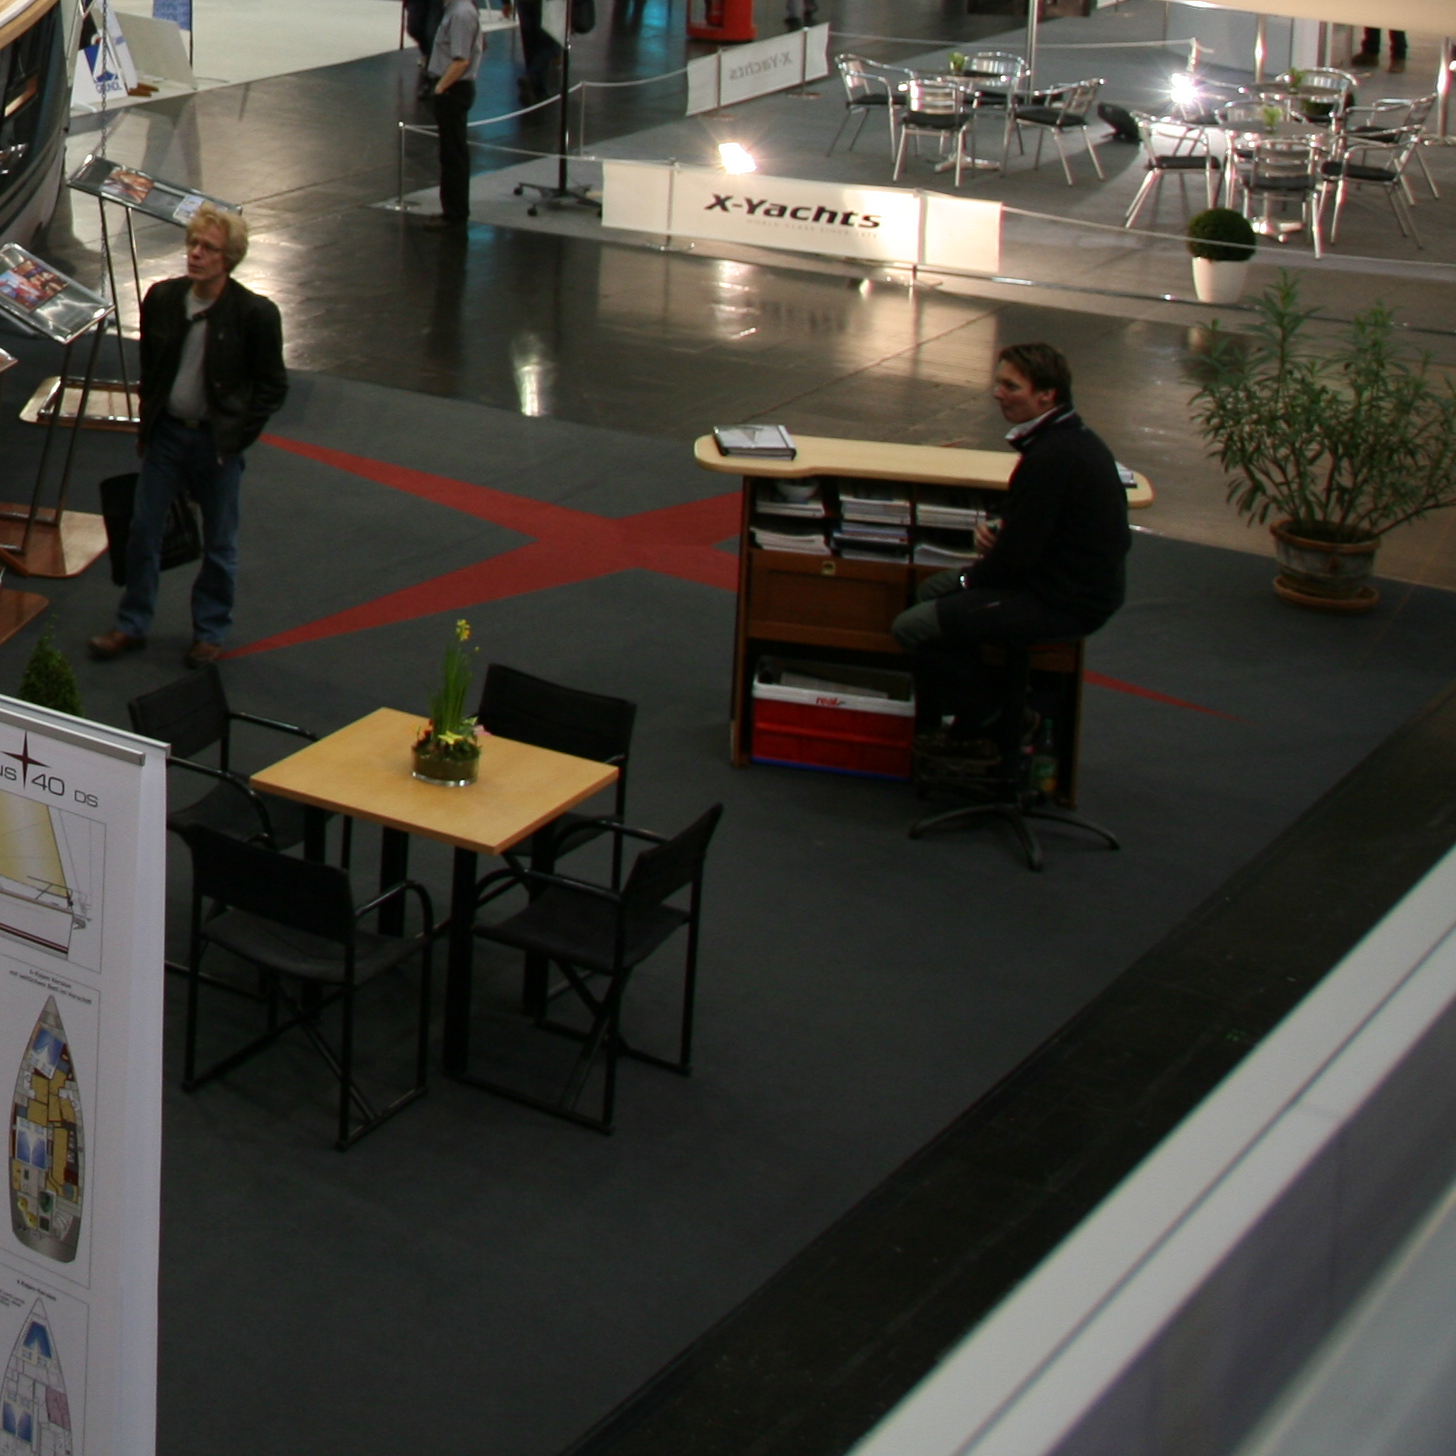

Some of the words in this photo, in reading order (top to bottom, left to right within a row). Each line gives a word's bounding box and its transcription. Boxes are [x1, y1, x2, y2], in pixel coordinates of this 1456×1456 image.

[704, 193, 882, 229] X-Yachts
[31, 773, 65, 796] 40
[74, 789, 99, 808] DS
